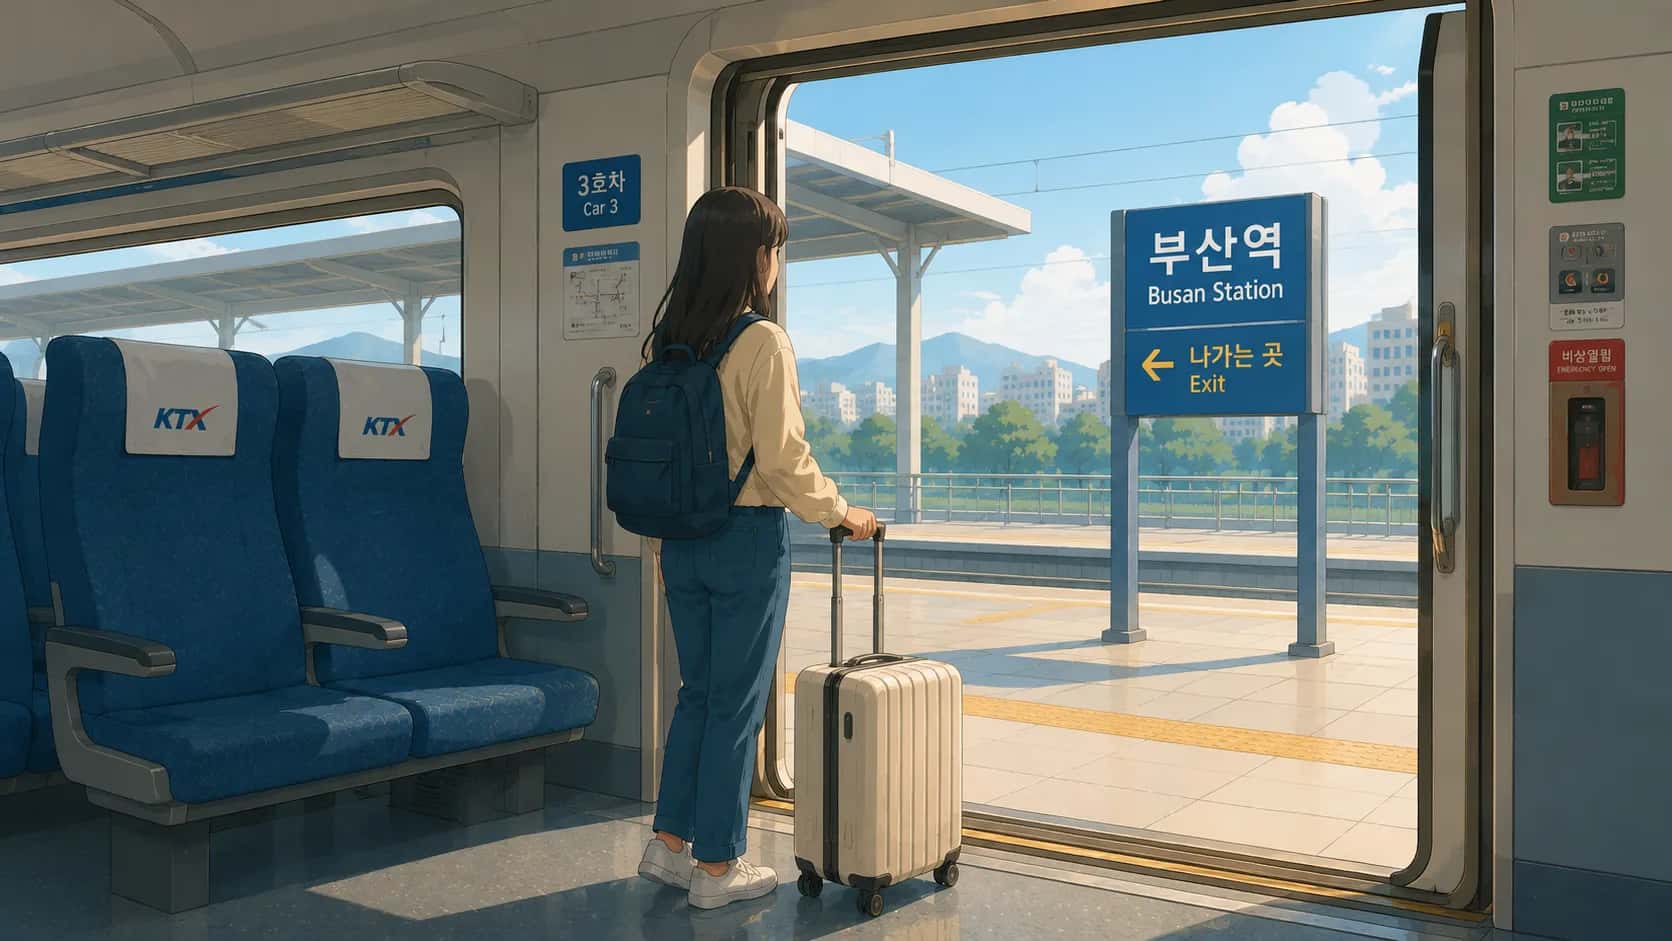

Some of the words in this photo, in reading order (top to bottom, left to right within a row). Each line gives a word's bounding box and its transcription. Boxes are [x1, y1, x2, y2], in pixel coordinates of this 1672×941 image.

[577, 170, 626, 197] 3호차
[583, 202, 606, 217] Car
[609, 198, 619, 214] 3
[1149, 222, 1281, 276] 부산역
[1148, 285, 1206, 305] Busan
[1213, 279, 1284, 302] Station
[1189, 343, 1255, 369] 나가는
[1262, 342, 1284, 368] 곳
[1190, 374, 1226, 393] Exit
[153, 404, 221, 431] KTX
[361, 414, 417, 437] KTX
